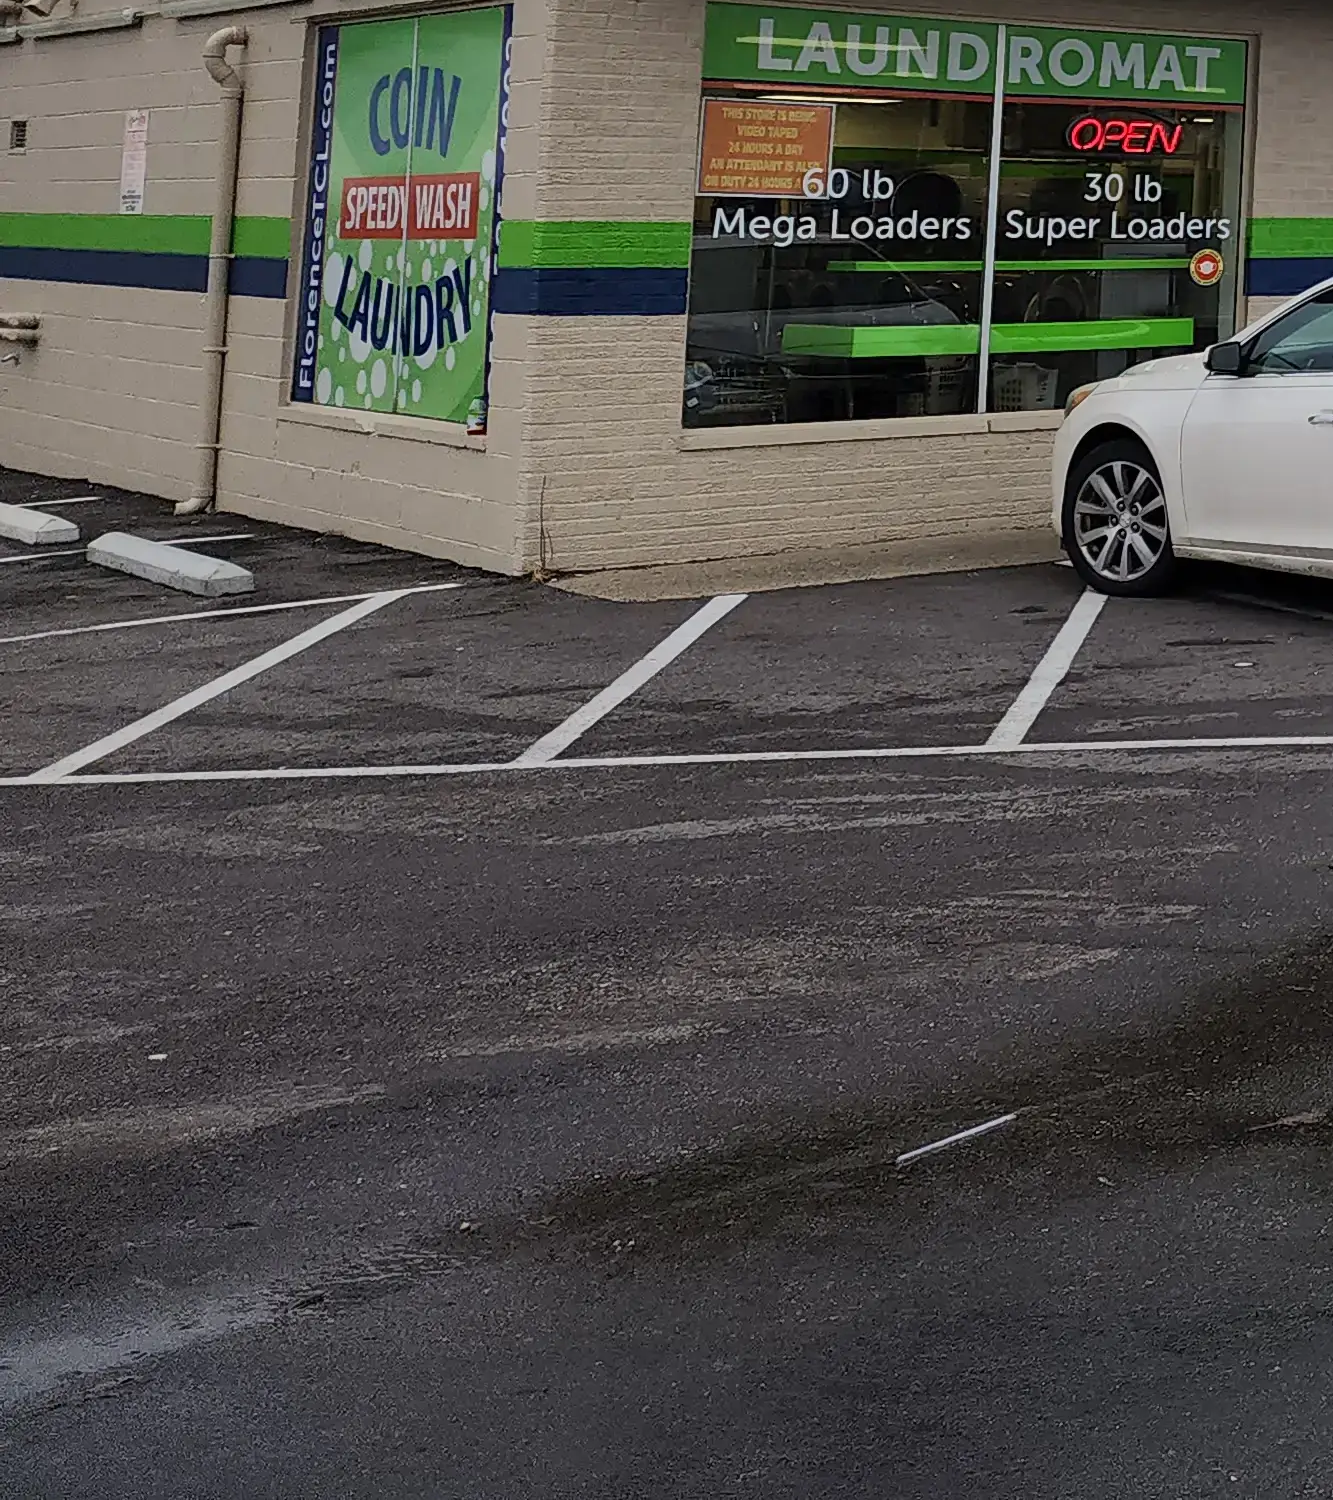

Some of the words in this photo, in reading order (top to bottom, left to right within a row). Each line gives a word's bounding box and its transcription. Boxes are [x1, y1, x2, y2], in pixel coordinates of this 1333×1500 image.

[756, 18, 1222, 93] LAUNDROMAT
[368, 66, 462, 158] COIN
[722, 107, 743, 119] THIS
[728, 141, 740, 153] 24
[1070, 117, 1184, 154] OPEN
[802, 167, 849, 199] 60
[861, 168, 894, 199] lb
[1084, 172, 1124, 202] 30
[1134, 172, 1162, 202] lb
[298, 43, 336, 389] FlorenceTCL.com
[345, 185, 408, 231] SPEEDY
[415, 182, 472, 230] WASH
[711, 208, 817, 248] Mega
[831, 208, 971, 240] Loaders
[1005, 210, 1101, 246] Super
[1110, 211, 1231, 241] Loaders
[334, 254, 472, 358] LAUNDRY
